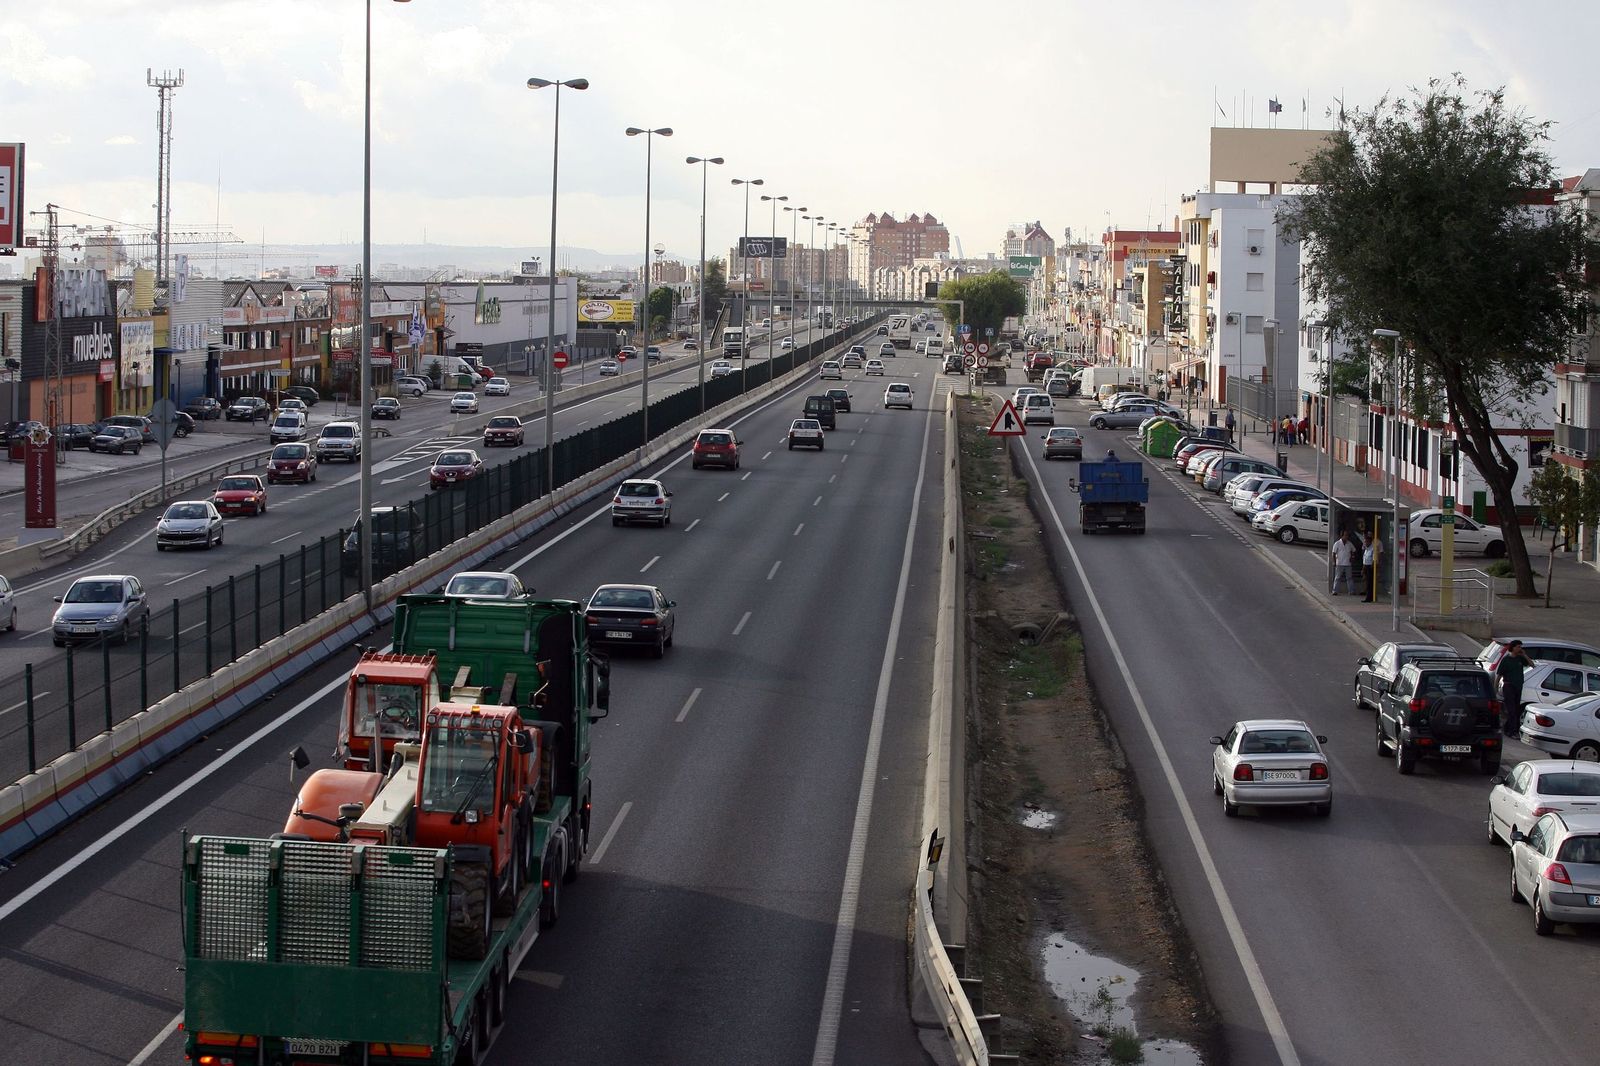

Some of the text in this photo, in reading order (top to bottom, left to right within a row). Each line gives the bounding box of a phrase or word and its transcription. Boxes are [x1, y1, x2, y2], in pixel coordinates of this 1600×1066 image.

[1174, 266, 1182, 323] ALCALA
[74, 321, 112, 362] muebles
[291, 1044, 316, 1054] 0470
